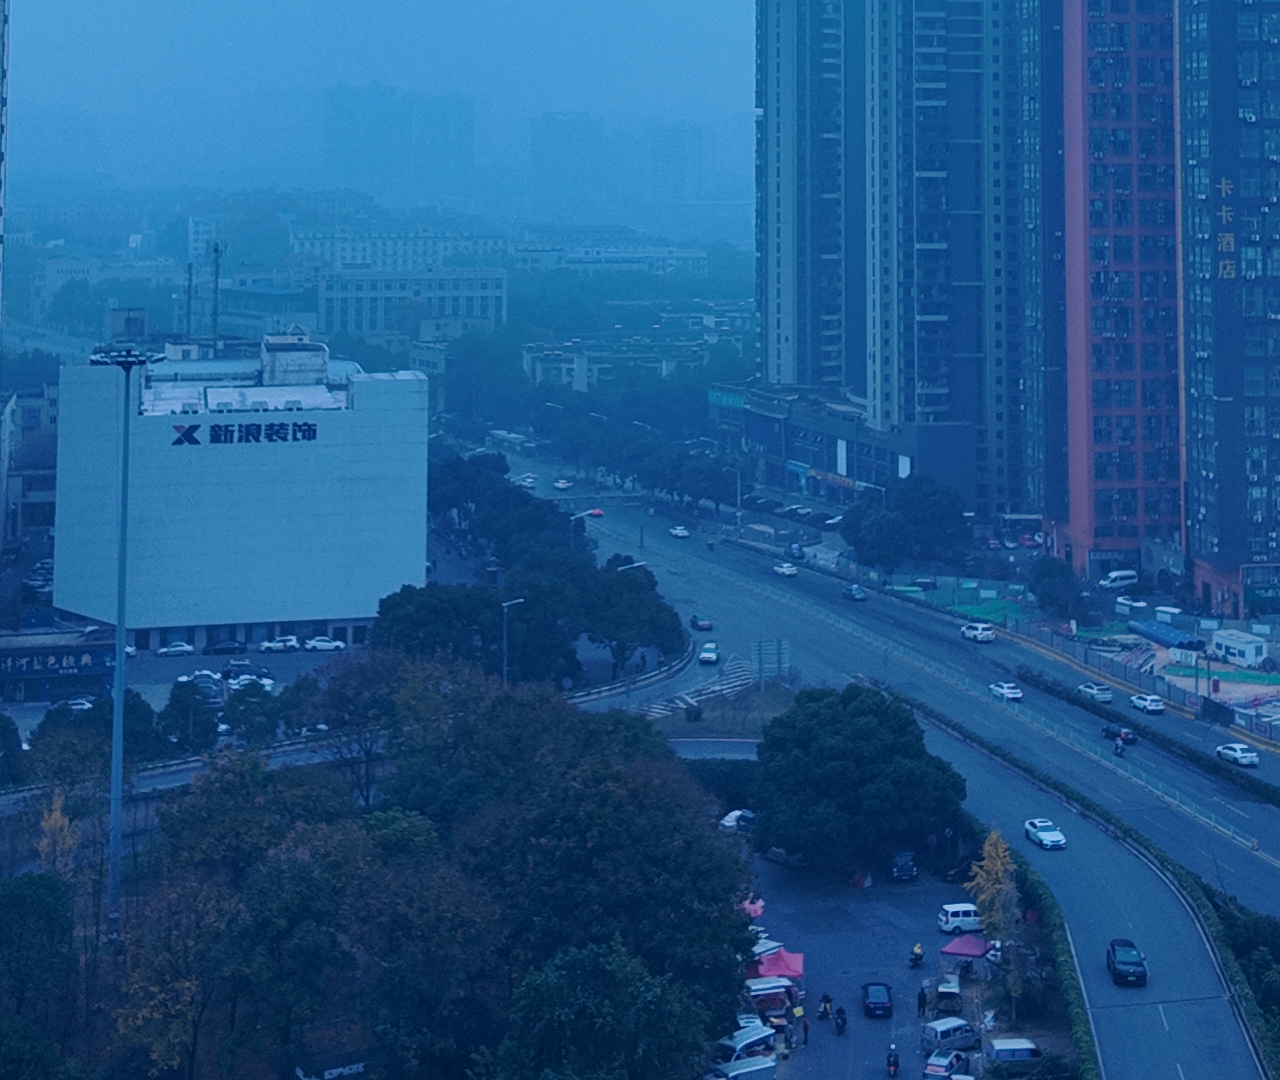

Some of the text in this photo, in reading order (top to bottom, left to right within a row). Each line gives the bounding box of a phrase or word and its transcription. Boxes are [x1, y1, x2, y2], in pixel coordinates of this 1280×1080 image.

[1215, 177, 1237, 279] 卡卡酒店
[209, 421, 317, 444] 新浪装饰
